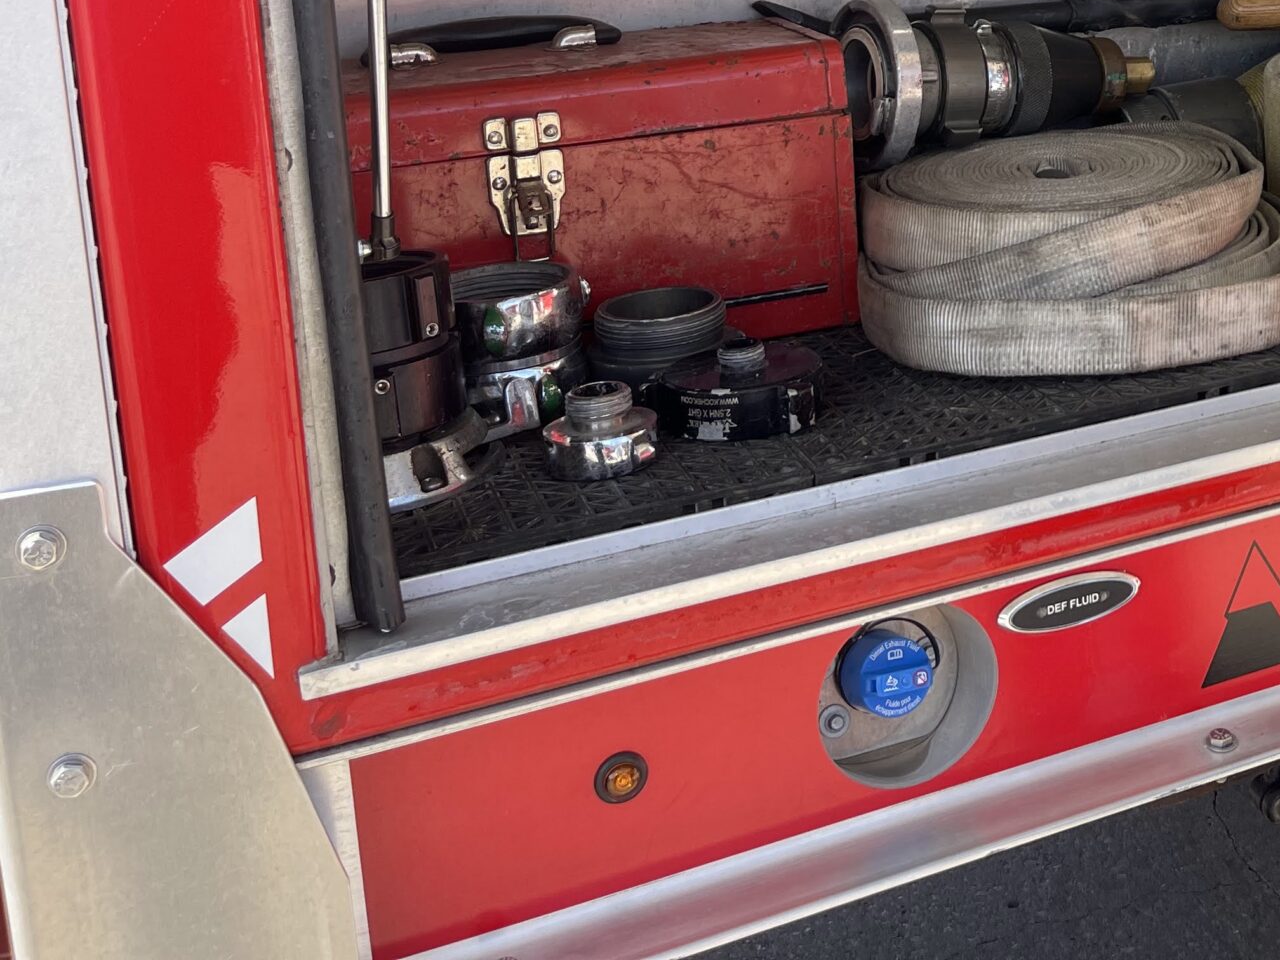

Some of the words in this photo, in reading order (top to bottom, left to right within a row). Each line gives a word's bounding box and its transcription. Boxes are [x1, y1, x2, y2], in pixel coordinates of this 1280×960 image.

[1047, 600, 1068, 616] DEF
[1069, 592, 1100, 610] FLUID
[884, 640, 906, 650] Exhaust
[906, 640, 920, 653] Fluid
